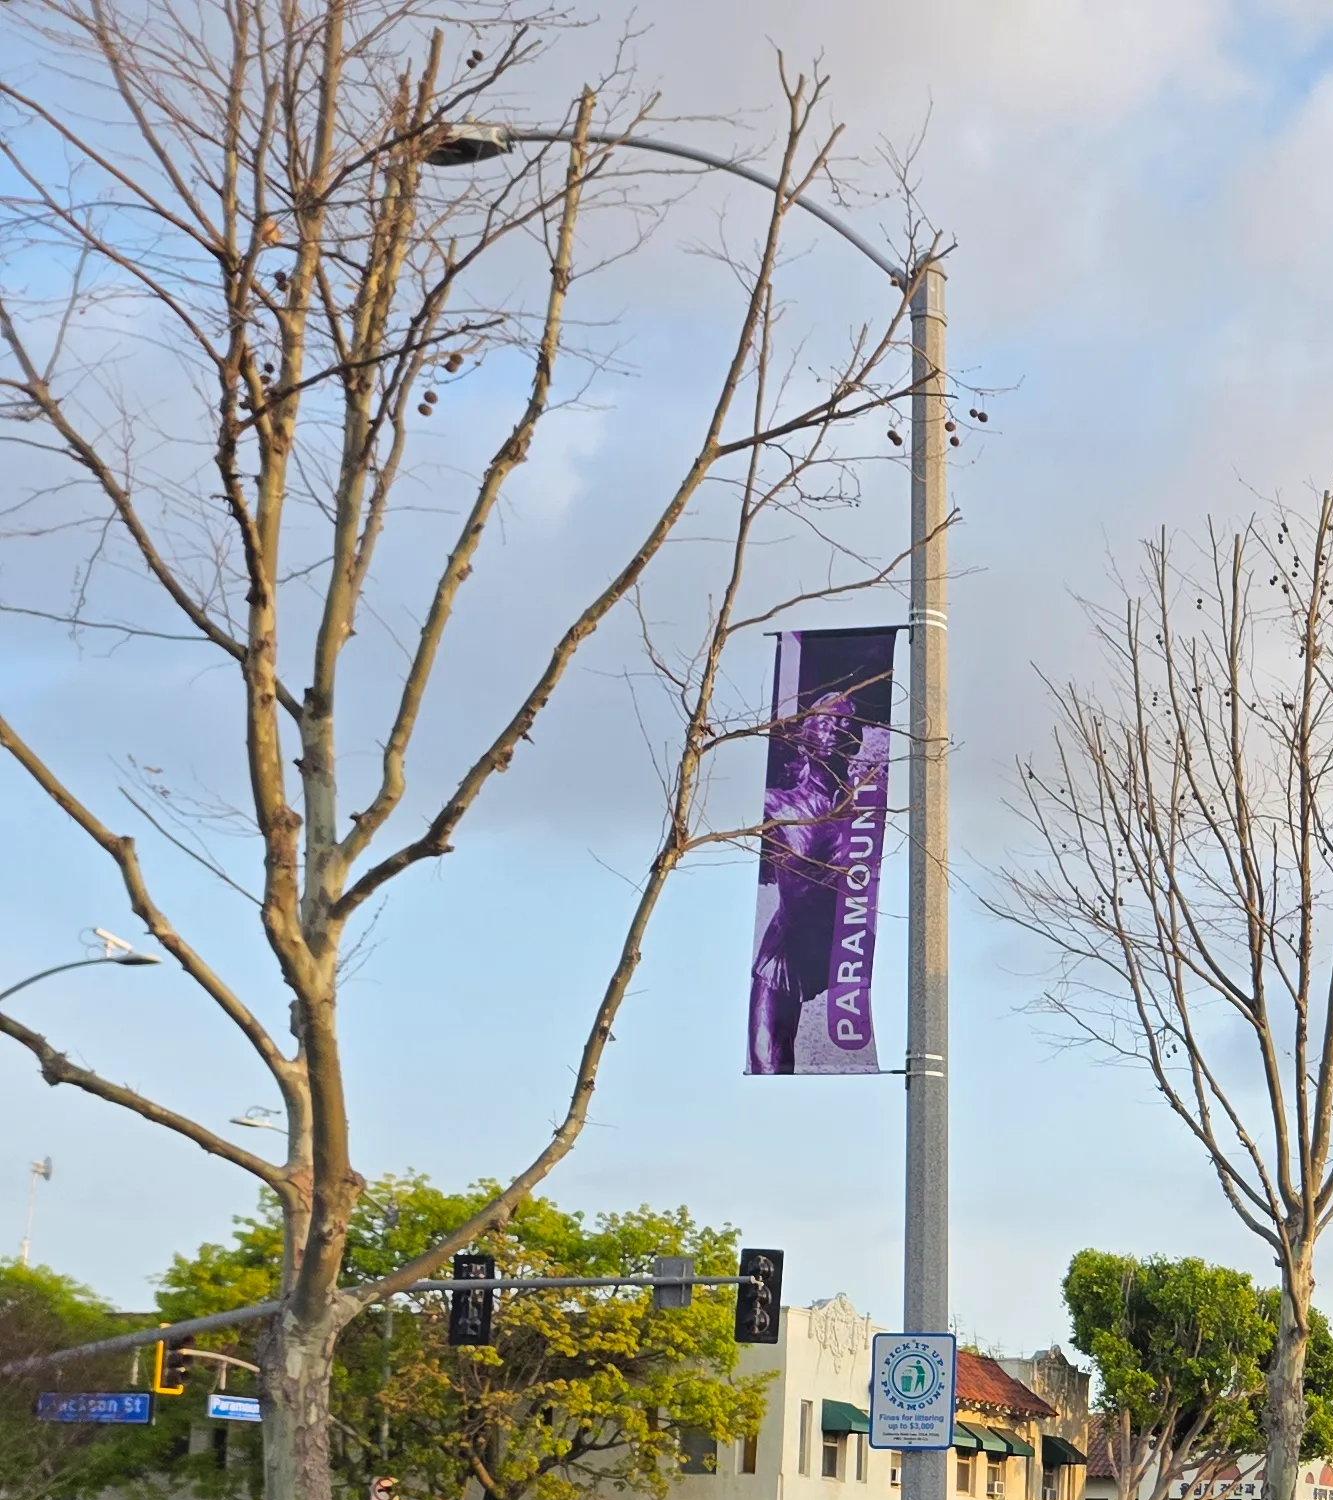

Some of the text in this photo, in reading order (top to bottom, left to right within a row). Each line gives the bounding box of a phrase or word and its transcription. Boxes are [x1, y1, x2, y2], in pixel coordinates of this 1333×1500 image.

[836, 776, 877, 1041] PARAMOUNT
[884, 1342, 944, 1366] PICK IT UP
[124, 1397, 141, 1413] St
[881, 1380, 945, 1411] PARAMOUNT
[915, 1414, 945, 1423] littering
